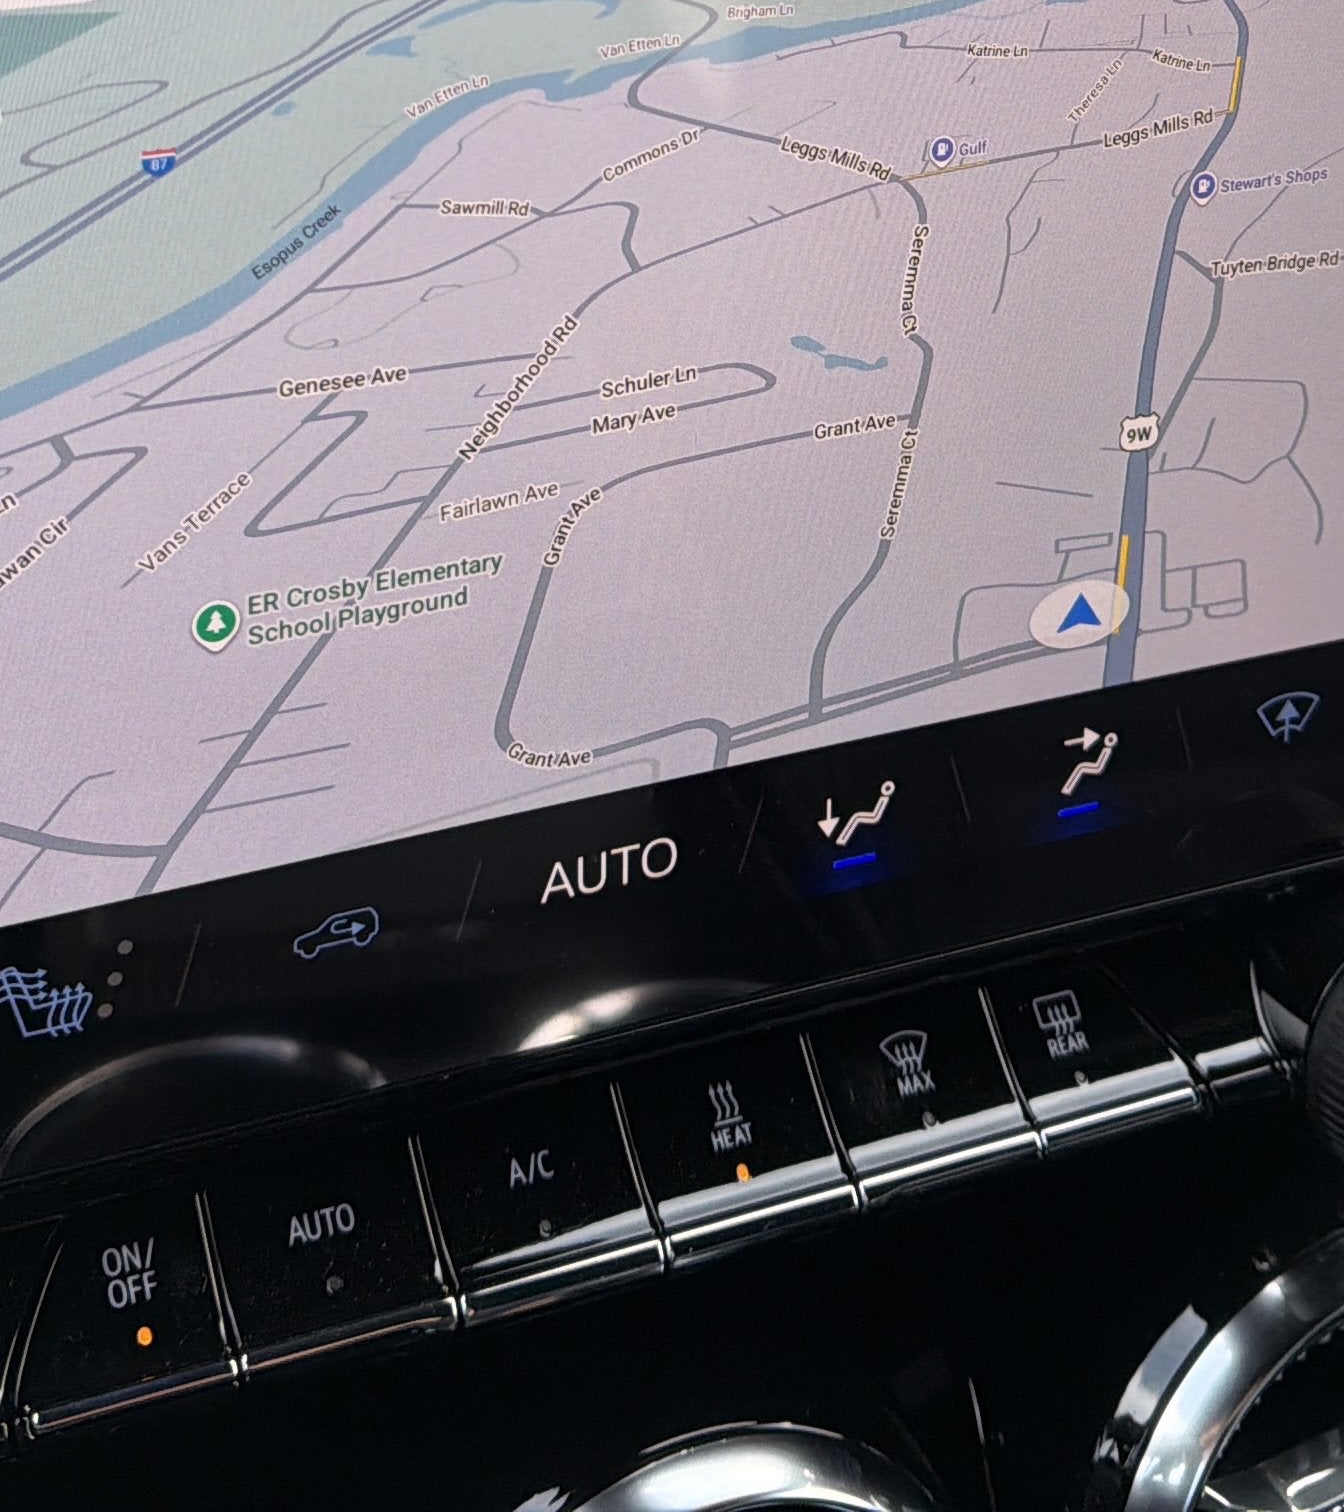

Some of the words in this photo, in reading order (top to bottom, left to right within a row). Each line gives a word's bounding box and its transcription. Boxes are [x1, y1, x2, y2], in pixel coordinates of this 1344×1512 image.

[727, 6, 775, 20] Brigham
[779, 4, 793, 17] Ln
[600, 45, 625, 59] Van
[628, 38, 660, 55] Etten
[664, 34, 680, 47] Ln
[967, 44, 1011, 58] Katrine
[1014, 45, 1027, 57] Ln
[1153, 49, 1194, 69] Katrine
[1197, 59, 1210, 71] Ln
[407, 99, 433, 119] Van
[435, 84, 469, 107] Etten
[472, 75, 489, 89] Ln
[1067, 74, 1109, 122] Theresa
[1108, 58, 1122, 76] Ln
[1103, 127, 1149, 148] Leggs
[1153, 117, 1189, 137] Mills
[1194, 108, 1213, 126] Rd
[602, 141, 679, 183] Commons
[681, 128, 700, 147] Dr
[781, 136, 826, 161] Leggs
[831, 148, 867, 173] Mills
[869, 162, 891, 181] Rd
[959, 141, 987, 156] Gulf
[152, 158, 167, 171] 87
[1221, 171, 1282, 193] Stewart's
[1286, 168, 1328, 184] Shops
[440, 200, 505, 216] Sawmill
[508, 200, 529, 216] Rd
[251, 238, 304, 281] Esopus
[302, 203, 342, 240] Creek
[902, 225, 929, 312] Seremma
[1211, 259, 1263, 277] Tuyten
[1268, 254, 1316, 274] Bridge
[1319, 251, 1339, 266] Rd
[902, 314, 917, 336] Ct
[279, 374, 366, 398] Genesee
[372, 367, 407, 385] Ave
[458, 341, 557, 460] Neighborhood
[552, 315, 578, 342] Rd
[601, 373, 672, 398] Schuler
[675, 367, 697, 383] Ln
[592, 413, 636, 434] Mary
[641, 404, 676, 424] Ave
[814, 419, 860, 440] Grant
[864, 414, 896, 431] Ave
[1127, 427, 1152, 443] 9W
[881, 451, 912, 539] Seremma
[901, 430, 918, 450] Ct
[440, 491, 518, 522] Fairlawn
[524, 482, 559, 502] Ave
[39, 518, 68, 545] Cir
[138, 532, 188, 573] Vans
[185, 471, 252, 531] Terrace
[544, 514, 573, 566] Grant
[571, 488, 601, 517] Ave
[248, 593, 278, 615] ER
[287, 578, 369, 607] Crosby
[376, 555, 503, 591] Elementary
[248, 612, 330, 645] School
[339, 586, 468, 628] Playground
[508, 742, 554, 768] Grant
[558, 751, 591, 767] Ave
[540, 836, 679, 905] AUTO
[1047, 1031, 1089, 1058] REAR
[896, 1070, 936, 1098] MAX
[711, 1122, 752, 1153] HEAT
[509, 1149, 555, 1189] A/C
[288, 1203, 355, 1248] AUTO
[102, 1237, 155, 1277] ON/
[107, 1270, 158, 1309] OFF
